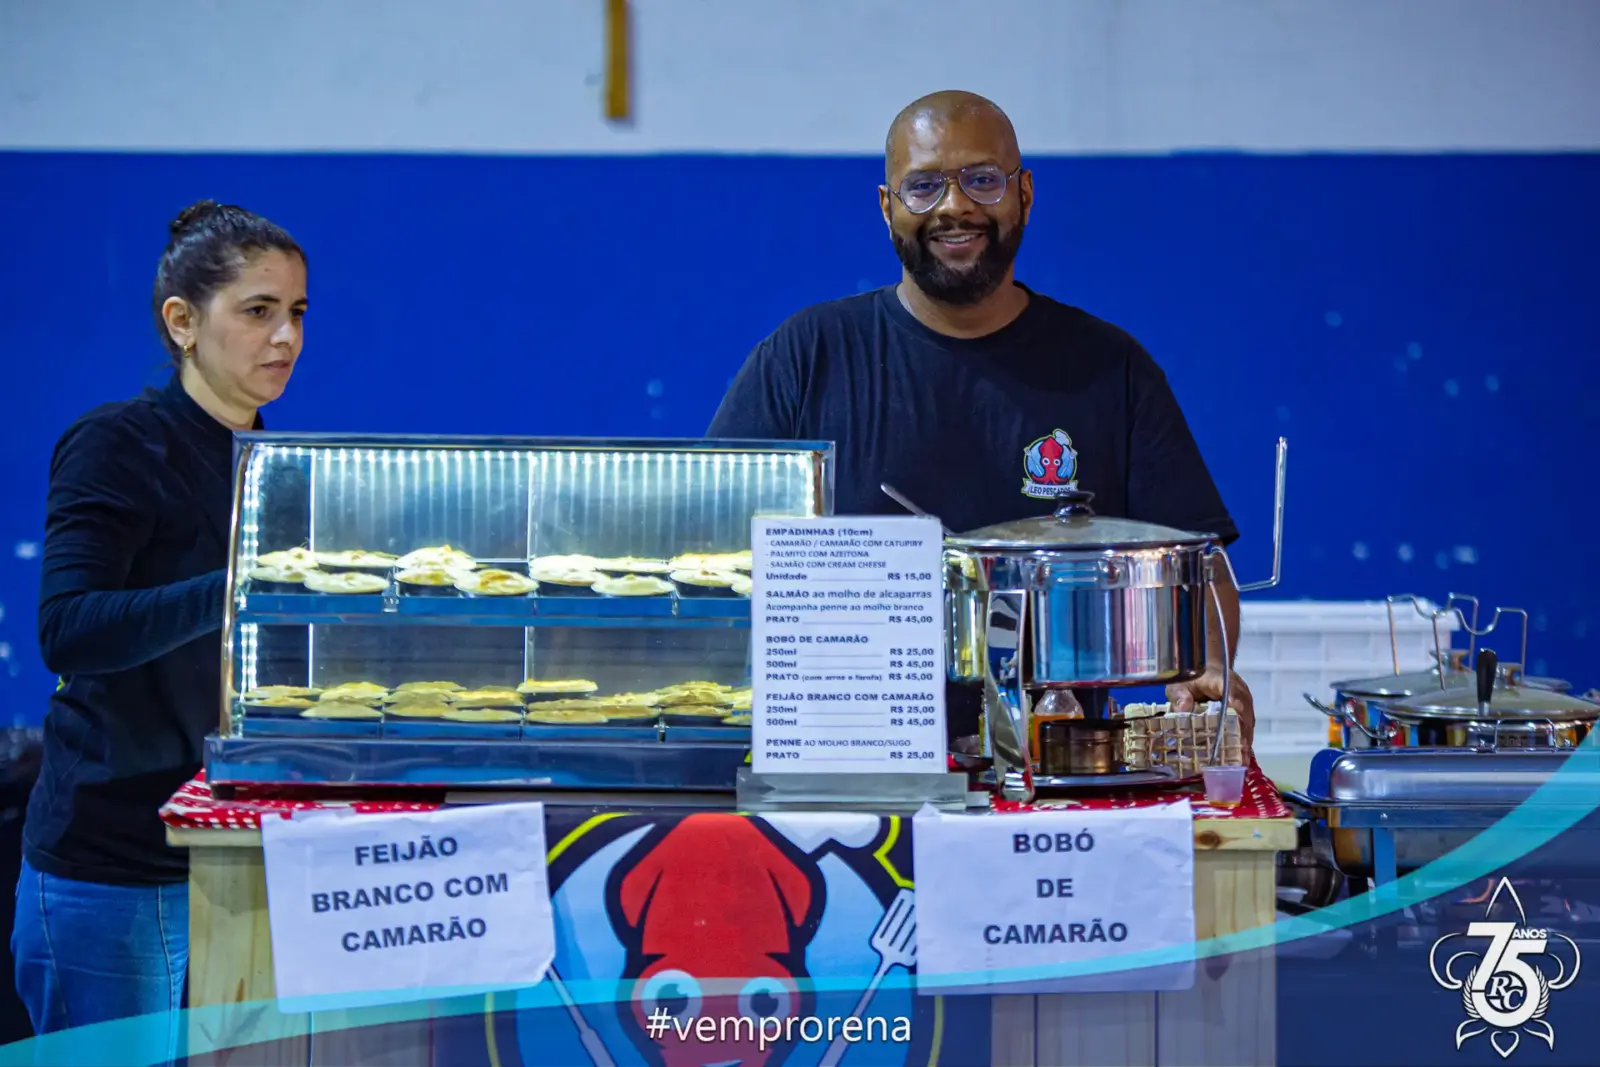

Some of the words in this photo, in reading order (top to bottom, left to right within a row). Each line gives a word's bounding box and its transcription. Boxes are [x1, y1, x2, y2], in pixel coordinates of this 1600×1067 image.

[1030, 486, 1042, 494] LEO
[766, 528, 835, 537] EMPADINHAS
[838, 528, 874, 538] (10cm)
[770, 539, 812, 547] CAMARÃO
[820, 539, 861, 547] CAMARÃO
[770, 550, 806, 558] PALMITO
[808, 550, 828, 558] COM
[830, 550, 869, 558] AZEITONA
[770, 560, 804, 568] SALMÃO
[766, 572, 808, 580] Unidade
[887, 572, 901, 580] R$
[905, 572, 932, 581] 15,00
[766, 588, 809, 598] SALMÃO
[828, 590, 860, 598] molho
[862, 590, 876, 598] de
[878, 590, 932, 600] alcaparras
[766, 603, 818, 613] Acompanha
[820, 605, 848, 613] penne
[863, 603, 891, 611] molho
[893, 603, 924, 611] branco
[905, 616, 933, 624] 45,00
[766, 634, 796, 643] BOBÓ
[799, 635, 813, 643] DE
[816, 634, 869, 643] CAMARÃO
[766, 648, 797, 656] 250ml
[890, 648, 903, 656] R$
[906, 648, 934, 657] 25,00
[906, 661, 934, 669] 45,00
[766, 673, 799, 681] PRATO
[802, 674, 822, 682] (com
[888, 673, 902, 681] R$
[905, 673, 933, 682] 45,00
[766, 692, 804, 701] FEIJÃO
[807, 693, 851, 701] BRANCO
[854, 693, 878, 701] COM
[881, 692, 934, 701] CAMARÃO
[766, 706, 797, 714] 250ml
[890, 706, 903, 714] R$
[907, 706, 935, 715] 25,00
[907, 719, 935, 727] 45,00
[906, 752, 934, 760] 25,00
[1012, 828, 1095, 853] BOBÓ
[355, 835, 458, 866] FEIJÃO
[1036, 878, 1073, 898] DE
[311, 881, 434, 913] BRANCO
[444, 873, 508, 898] COM
[341, 916, 486, 952] CAMARÃO
[983, 918, 1128, 944] CAMARÃO
